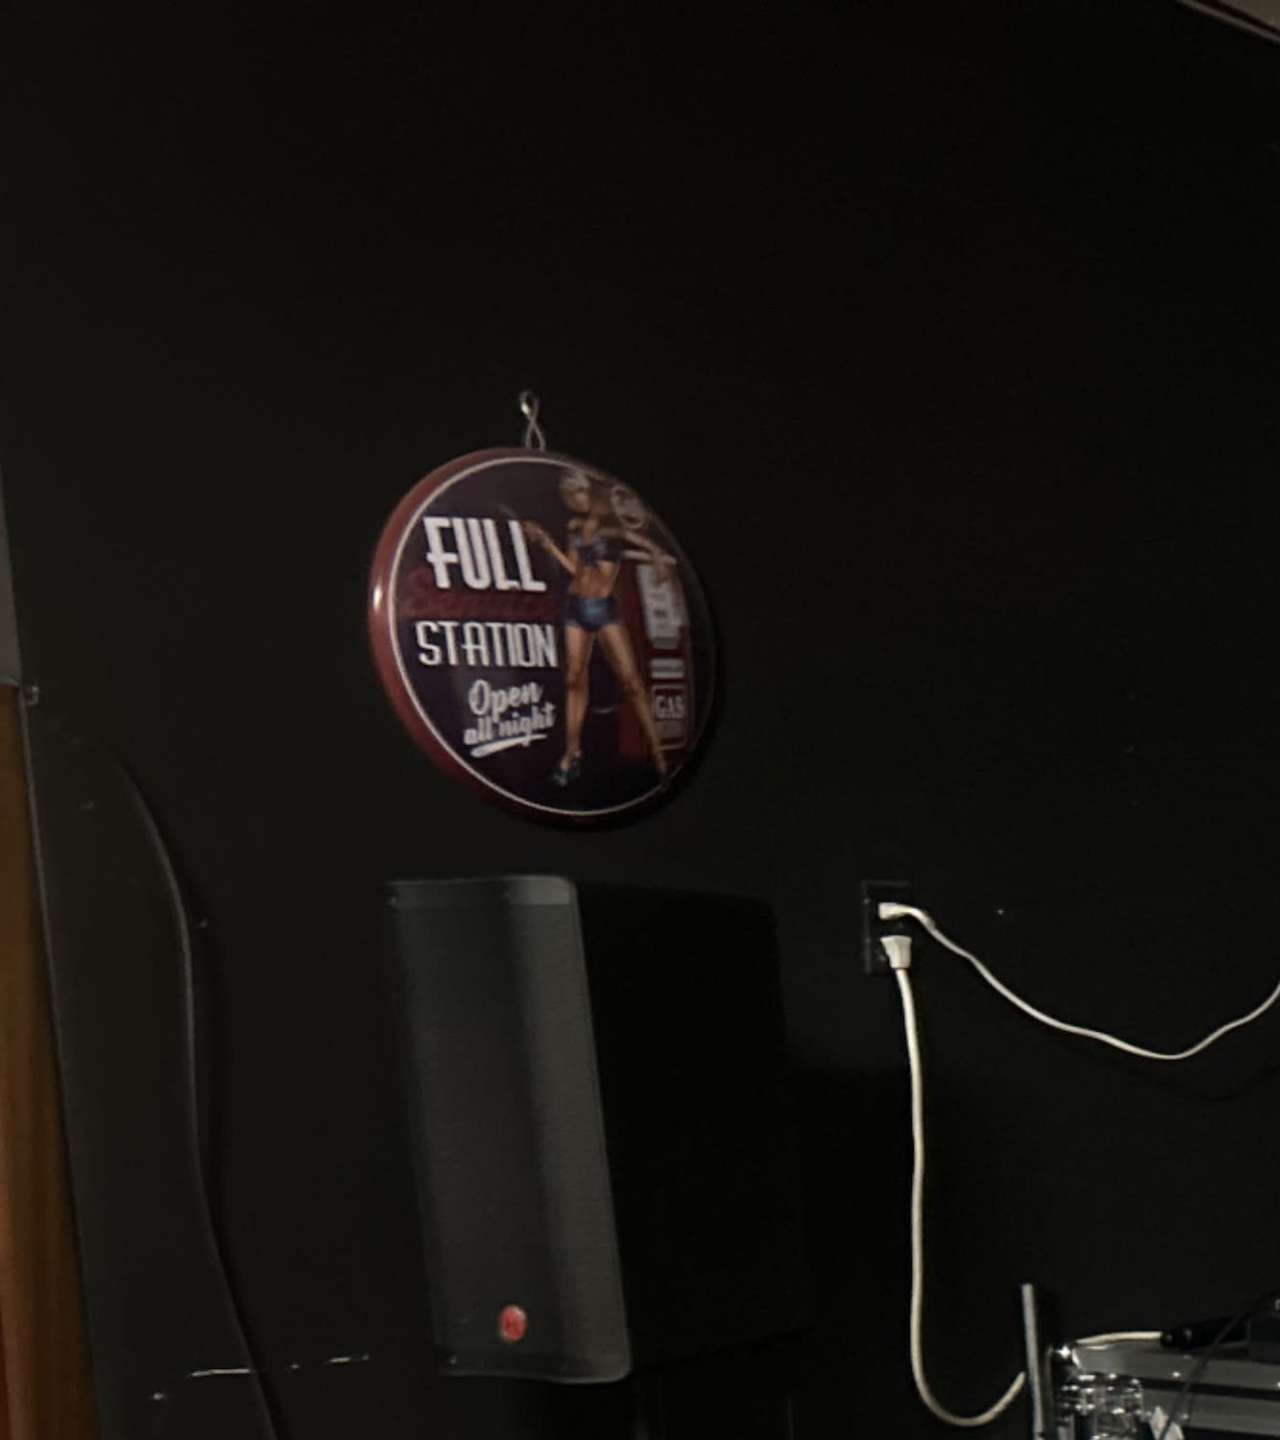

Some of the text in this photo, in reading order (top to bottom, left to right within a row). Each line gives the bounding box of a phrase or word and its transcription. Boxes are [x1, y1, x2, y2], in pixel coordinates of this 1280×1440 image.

[423, 516, 547, 592] FULL
[416, 621, 558, 667] STATION
[468, 679, 542, 718] Open
[464, 703, 557, 745] all night
